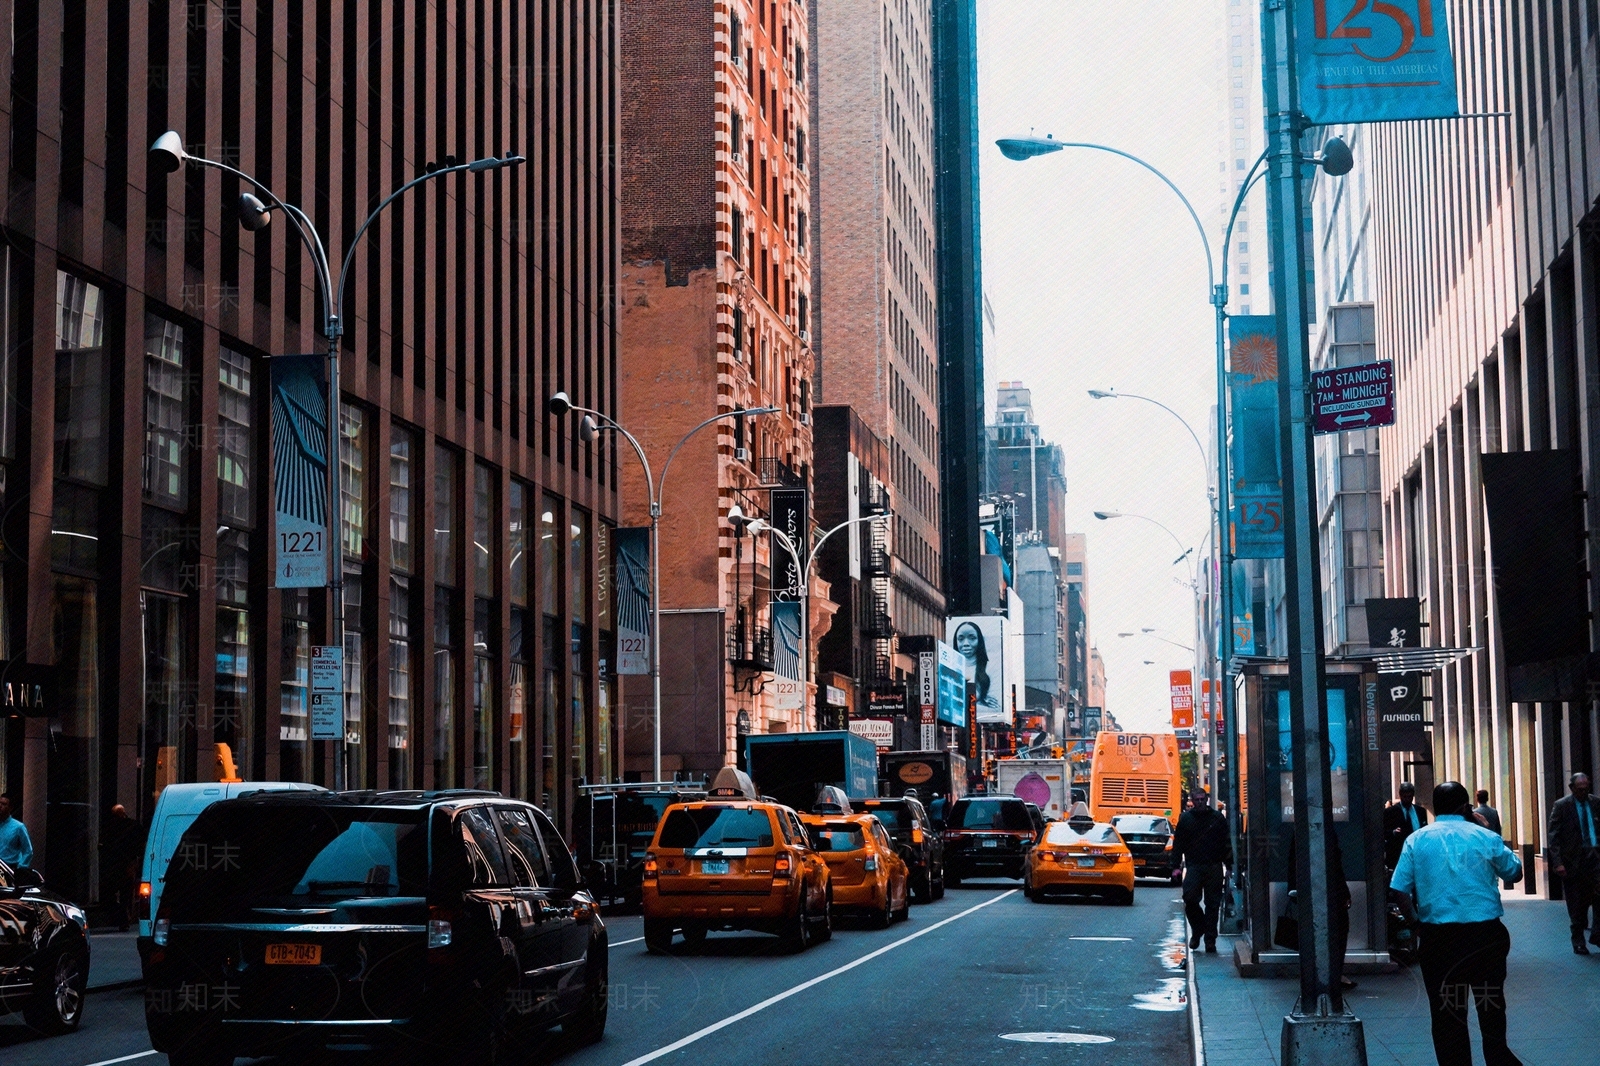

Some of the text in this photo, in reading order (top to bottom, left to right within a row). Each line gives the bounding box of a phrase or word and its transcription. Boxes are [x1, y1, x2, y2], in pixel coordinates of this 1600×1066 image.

[1352, 66, 1364, 75] OF
[1366, 65, 1388, 75] THE
[1389, 64, 1438, 74] AMERICAS
[1316, 367, 1387, 389] NO STANDING
[1317, 392, 1334, 404] 7AM
[1342, 382, 1388, 400] MIDNIGHT
[1321, 398, 1383, 412] INCLUDING SUNDAY
[281, 532, 322, 553] 1221
[621, 638, 645, 652] 1221
[314, 648, 320, 657] 3
[776, 683, 797, 693] 1221
[314, 695, 320, 704] 6
[1366, 683, 1379, 751] Newsstand
[1383, 713, 1420, 722] SUSHIDEN
[969, 694, 977, 758] Superdry
[1117, 735, 1138, 746] BIG
[1117, 746, 1138, 756] BUS
